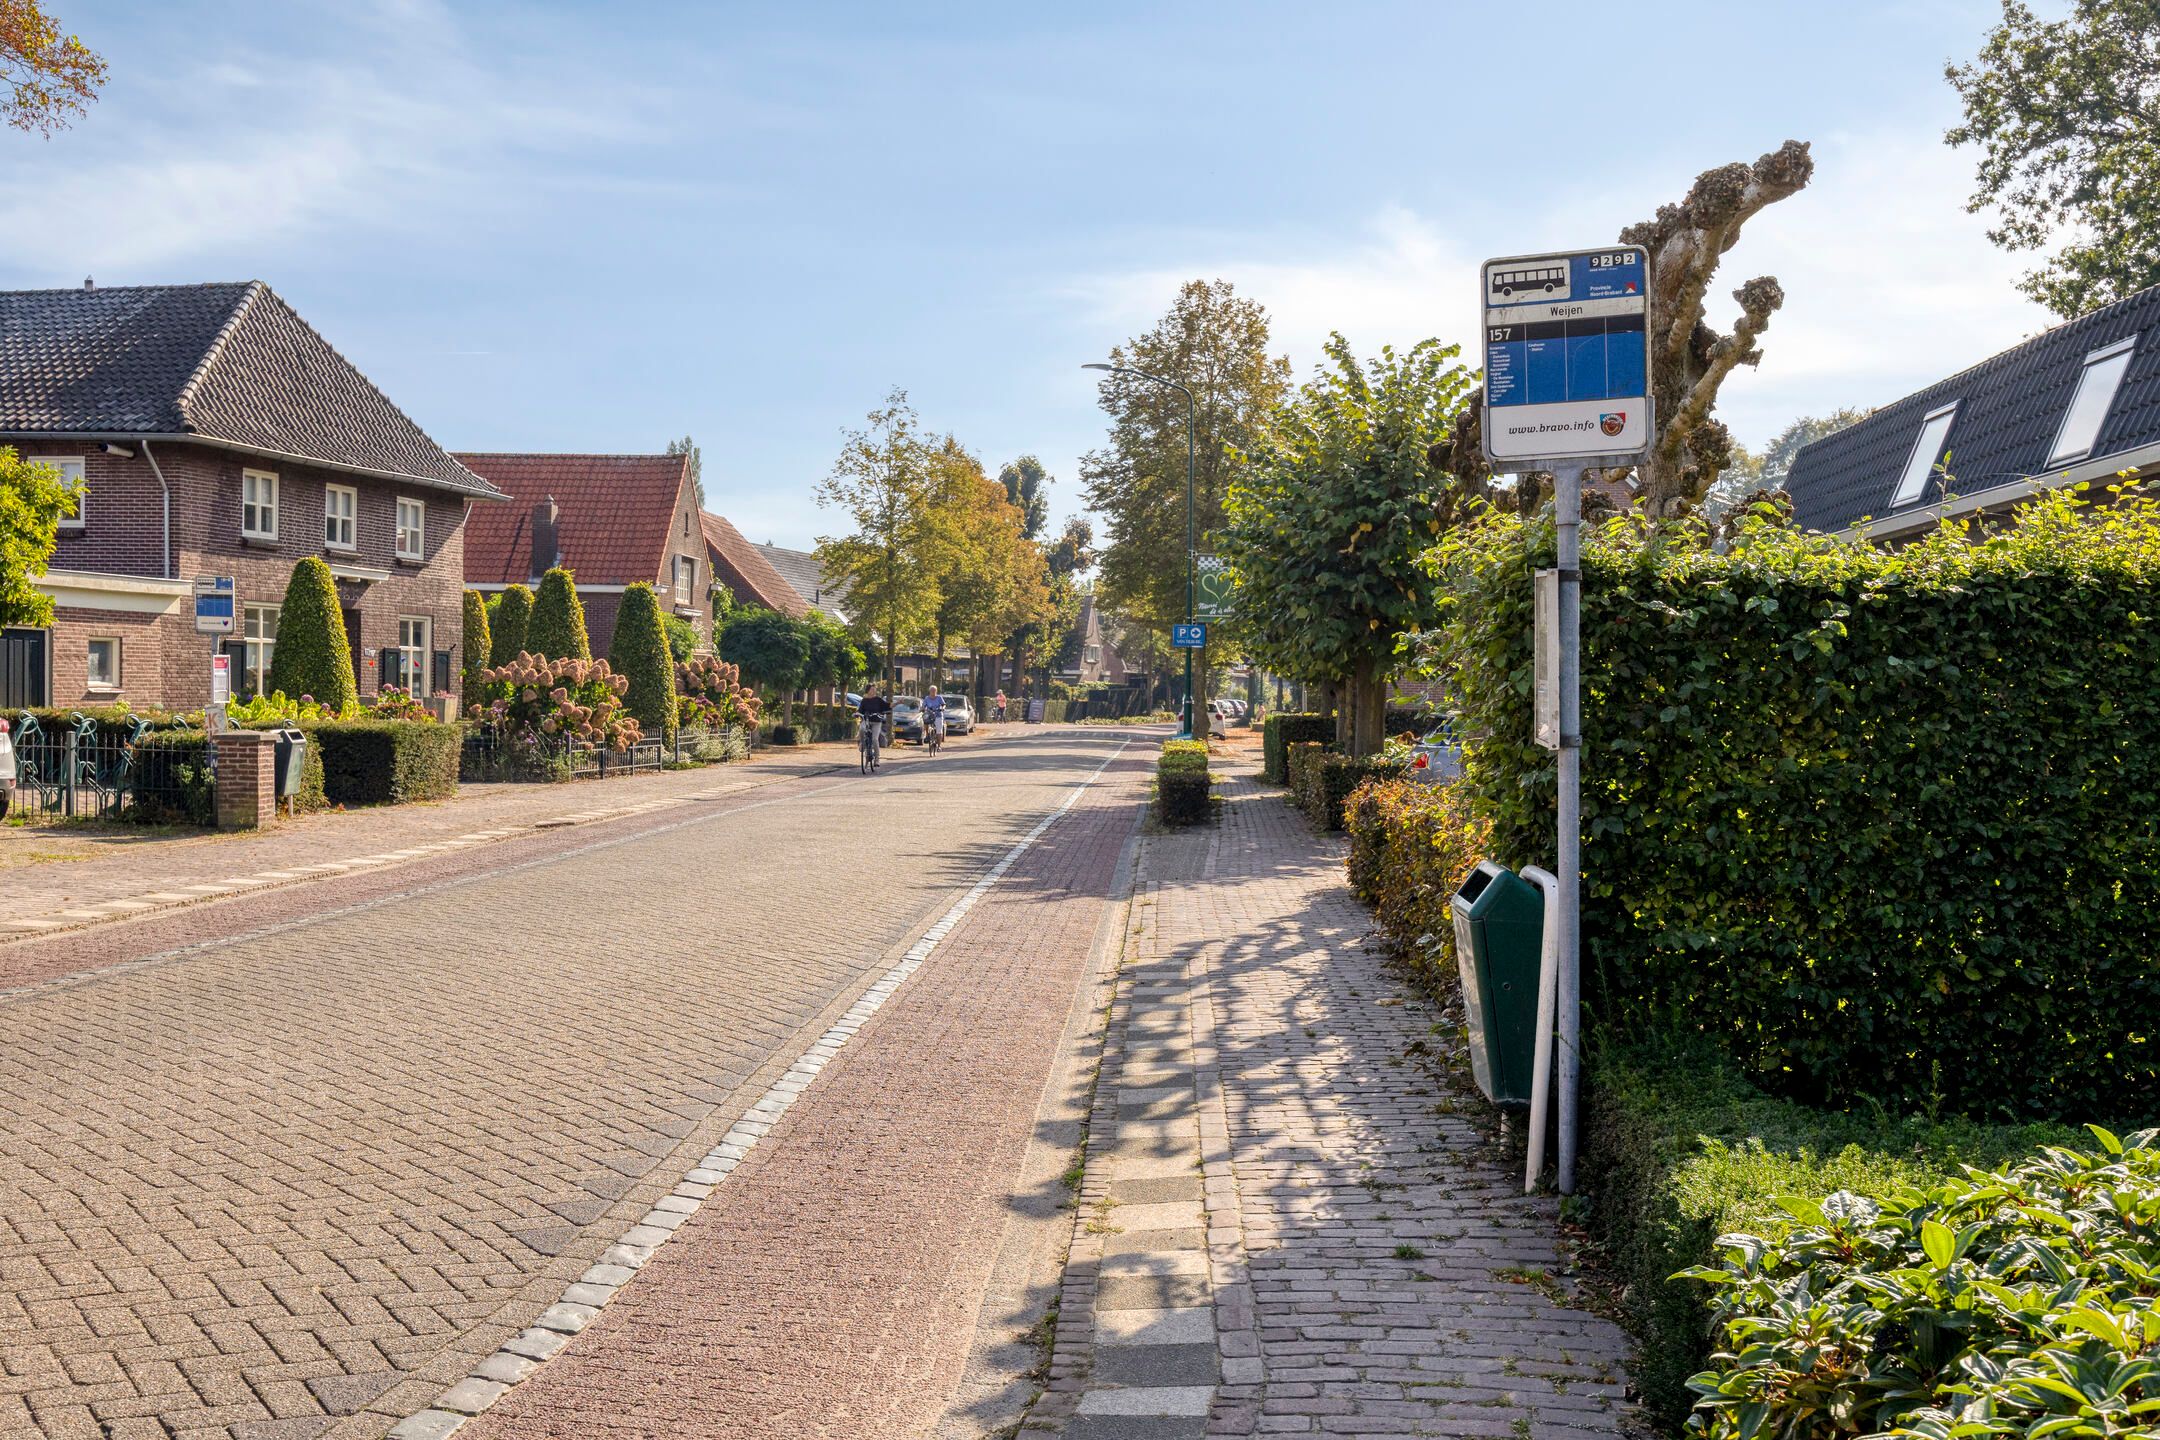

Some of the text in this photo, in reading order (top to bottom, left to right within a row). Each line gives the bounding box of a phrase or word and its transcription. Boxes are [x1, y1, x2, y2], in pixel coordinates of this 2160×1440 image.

[1591, 254, 1634, 267] 9292
[1550, 306, 1583, 318] Weijen
[1489, 328, 1512, 342] 157
[1508, 420, 1595, 435] www.bravo.info
